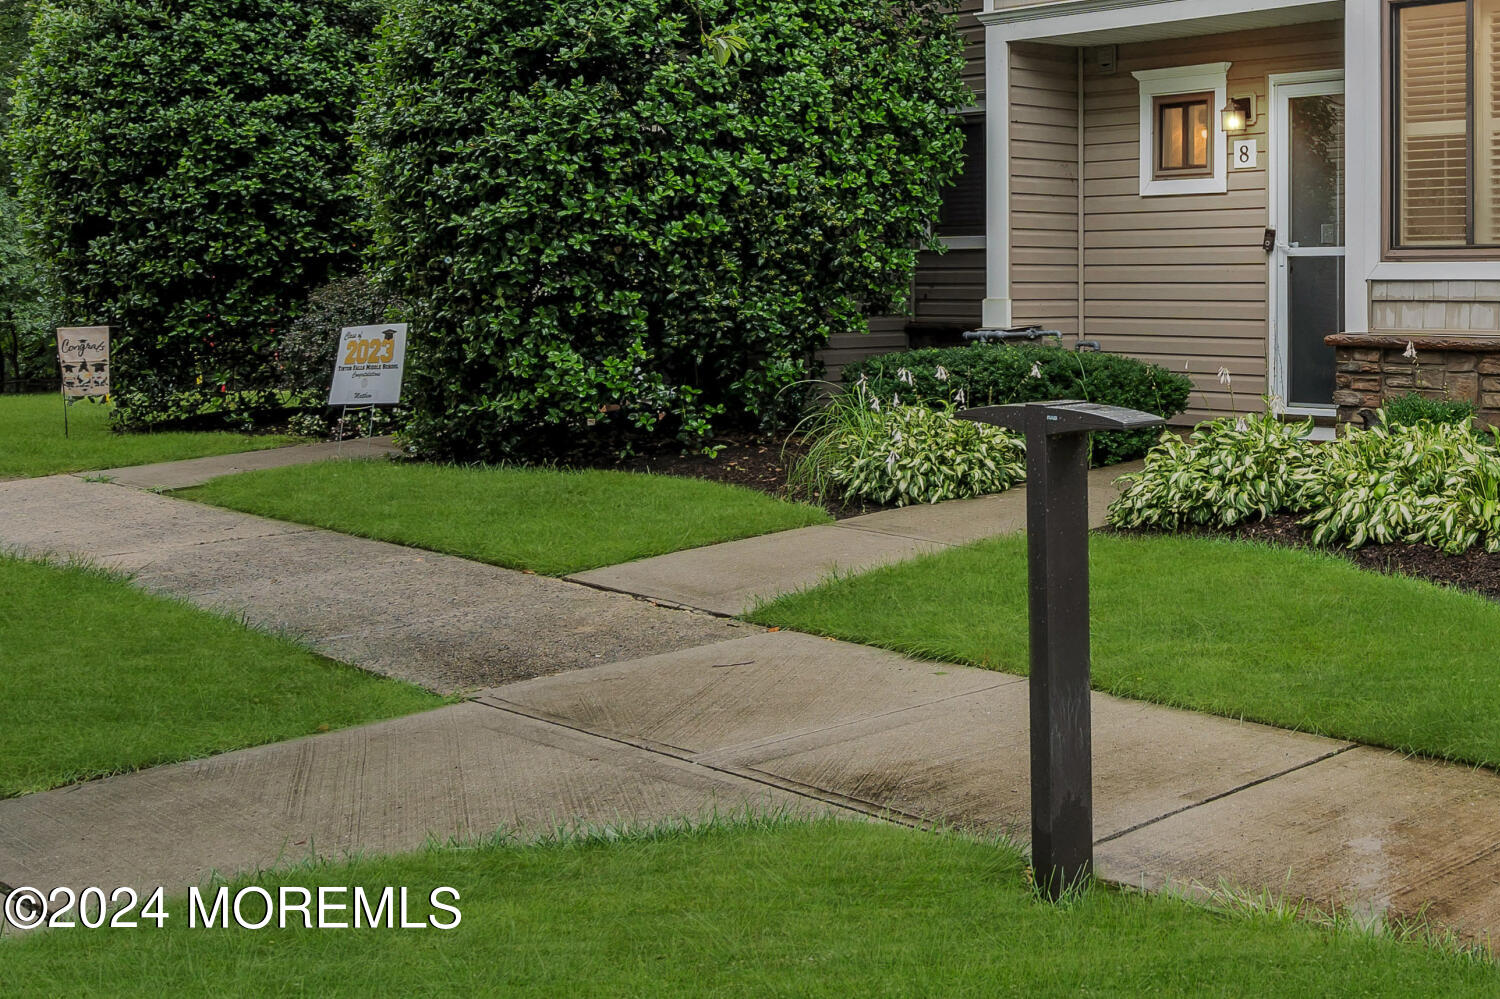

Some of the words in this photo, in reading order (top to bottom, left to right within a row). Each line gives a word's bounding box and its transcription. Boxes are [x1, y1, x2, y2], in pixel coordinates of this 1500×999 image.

[1239, 145, 1249, 163] 8
[61, 338, 106, 357] Congrats
[343, 338, 396, 365] 2023
